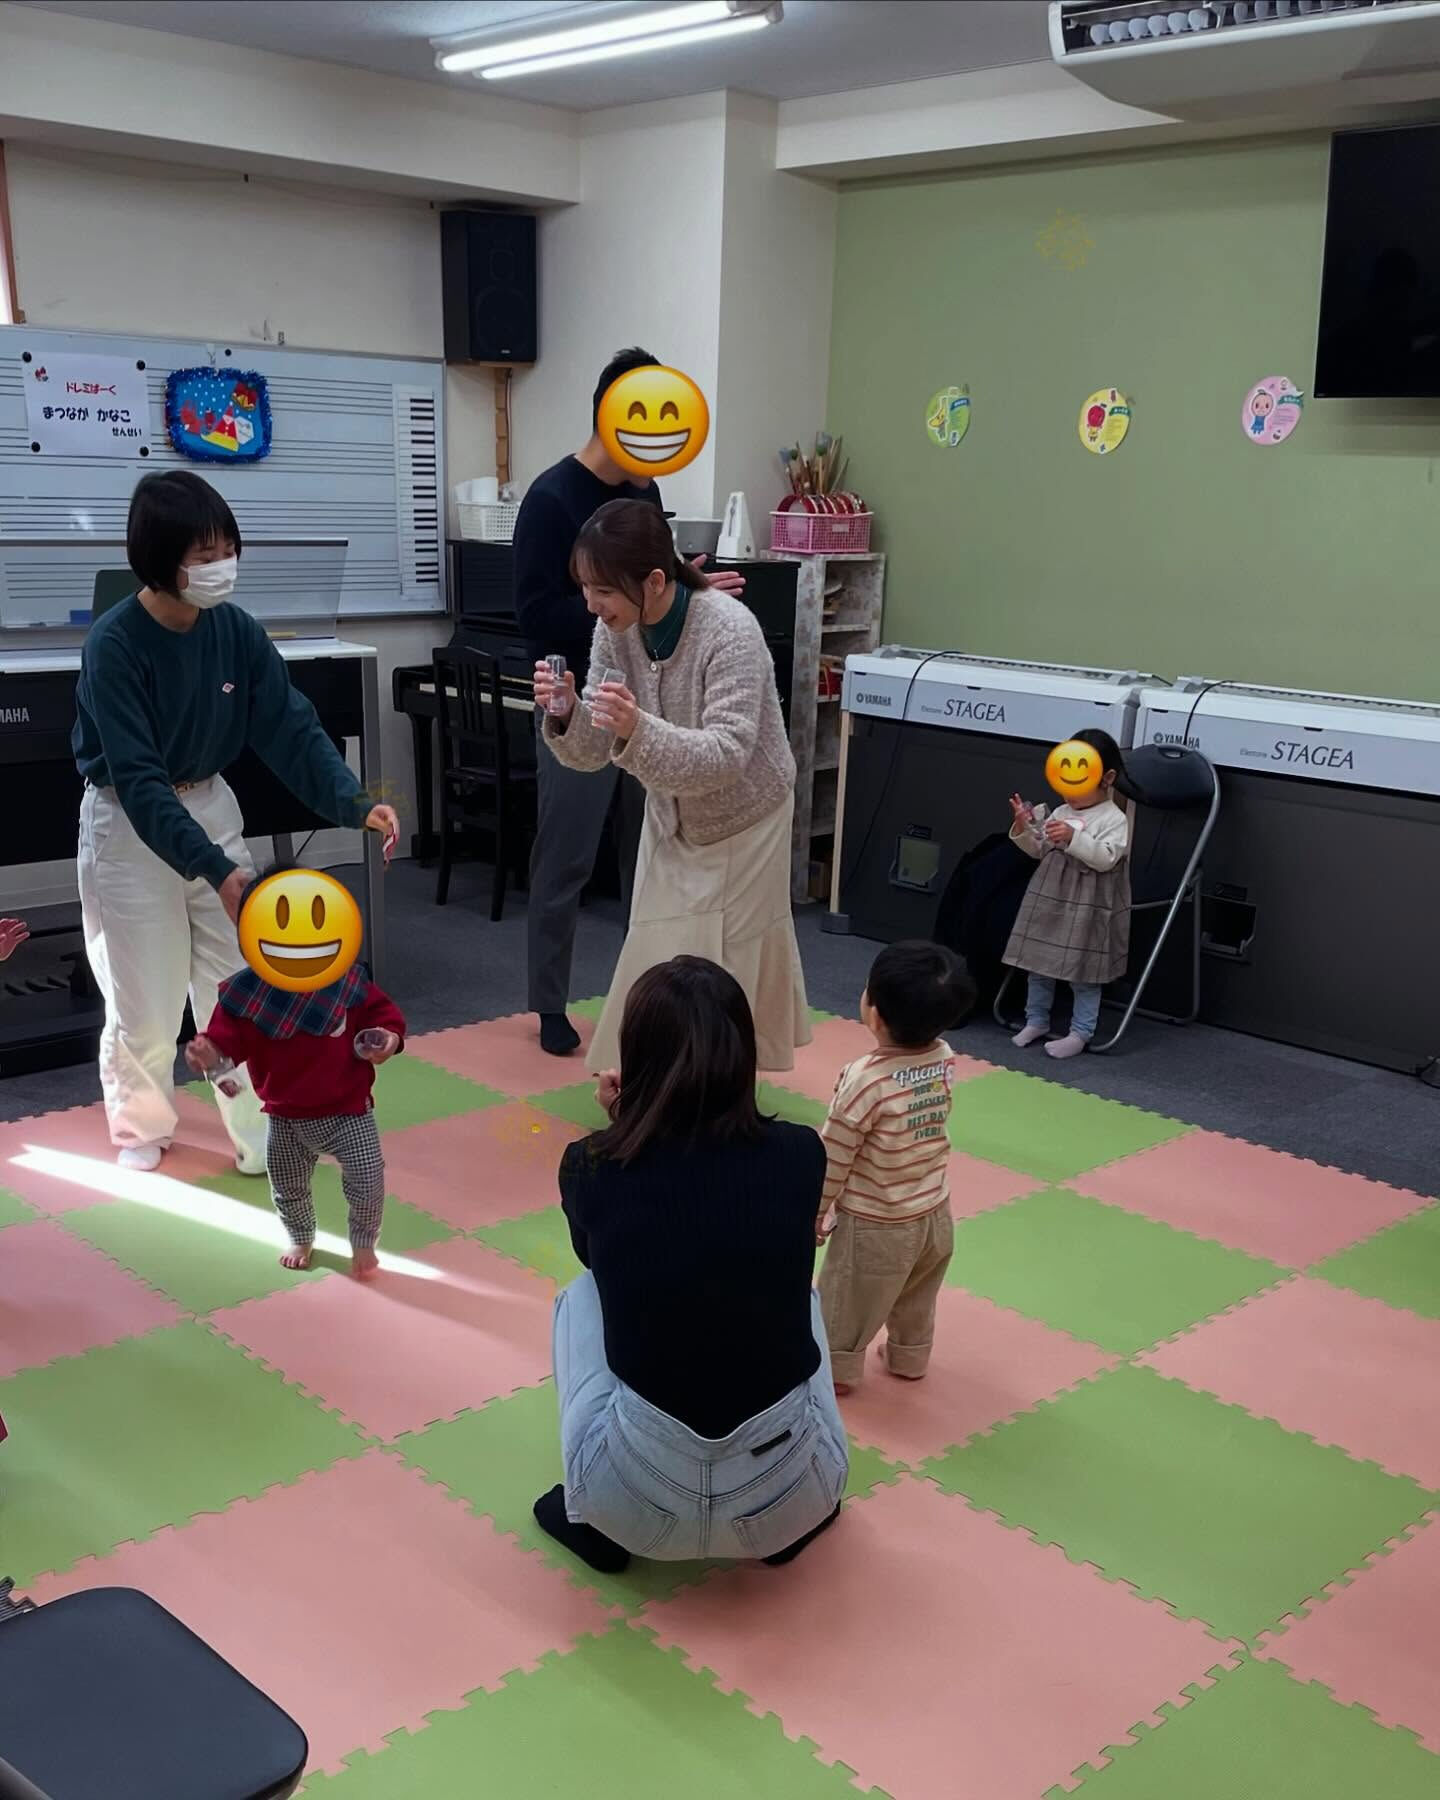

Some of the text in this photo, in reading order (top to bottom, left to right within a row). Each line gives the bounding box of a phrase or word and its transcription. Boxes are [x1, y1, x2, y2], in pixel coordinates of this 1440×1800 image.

[112, 427, 142, 437] せんせい
[943, 699, 1006, 723] STAGEA
[1165, 734, 1200, 749] YAMHA
[1271, 741, 1354, 769] STAGEA
